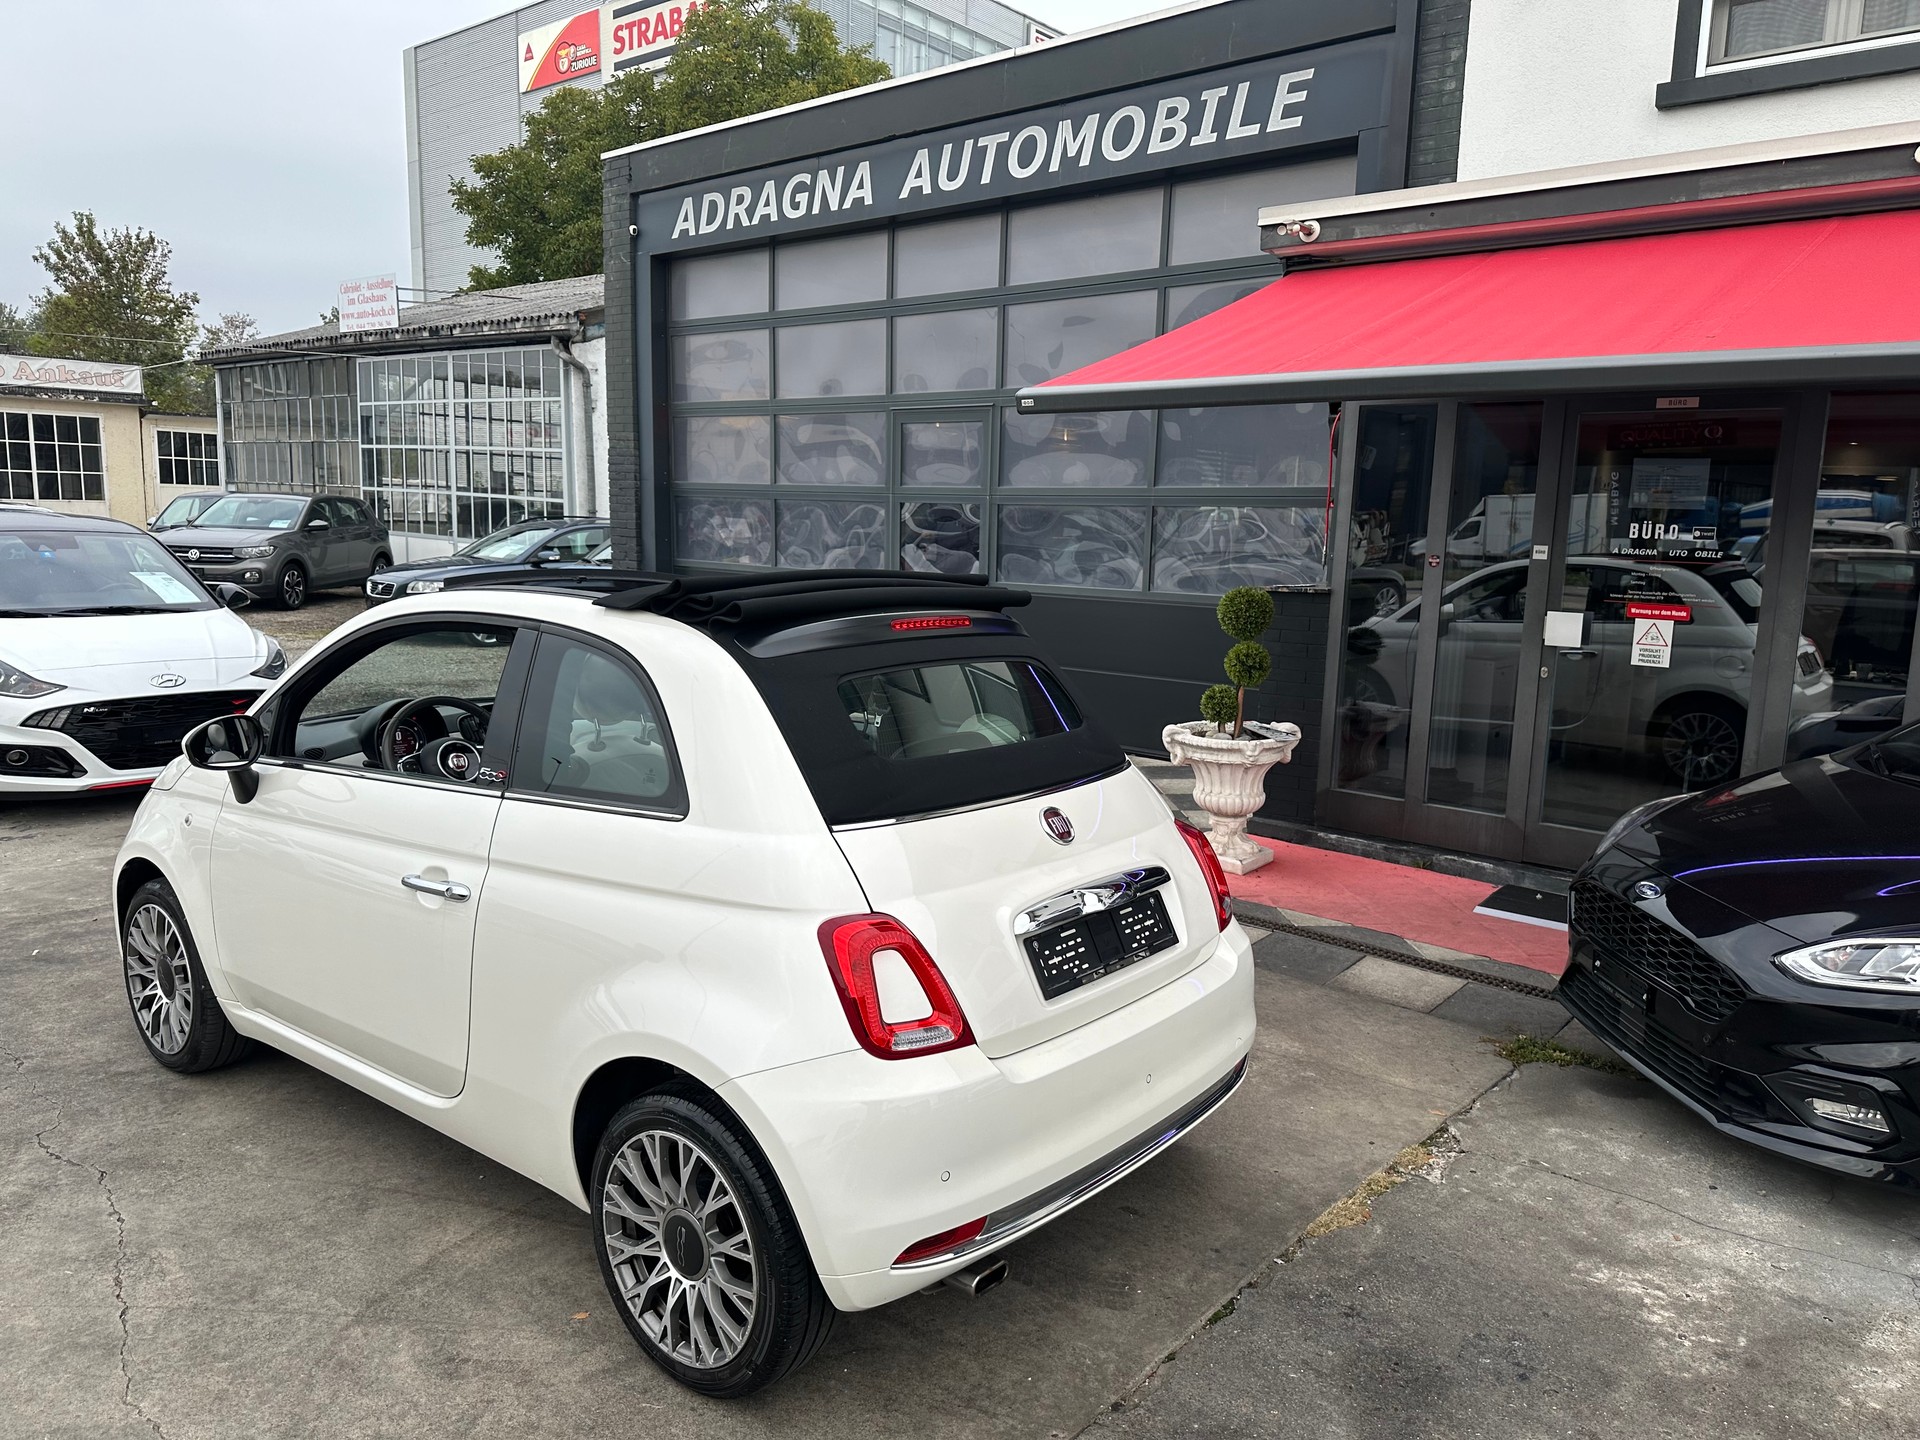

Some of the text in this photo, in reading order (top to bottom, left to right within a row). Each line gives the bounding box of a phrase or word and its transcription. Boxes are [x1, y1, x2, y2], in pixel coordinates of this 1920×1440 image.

[571, 56, 597, 72] ZURIQUE
[671, 68, 1315, 239] ADRAGNA AUTOMOBILE
[347, 292, 387, 306] im Glashaus
[341, 305, 396, 321] www.auto-koch.ch
[14, 361, 124, 387] Ankauf
[1620, 427, 1703, 441] QUALITY
[1629, 520, 1679, 540] BÜRO
[1631, 607, 1651, 615] Warnung
[1048, 815, 1073, 835] FIAT
